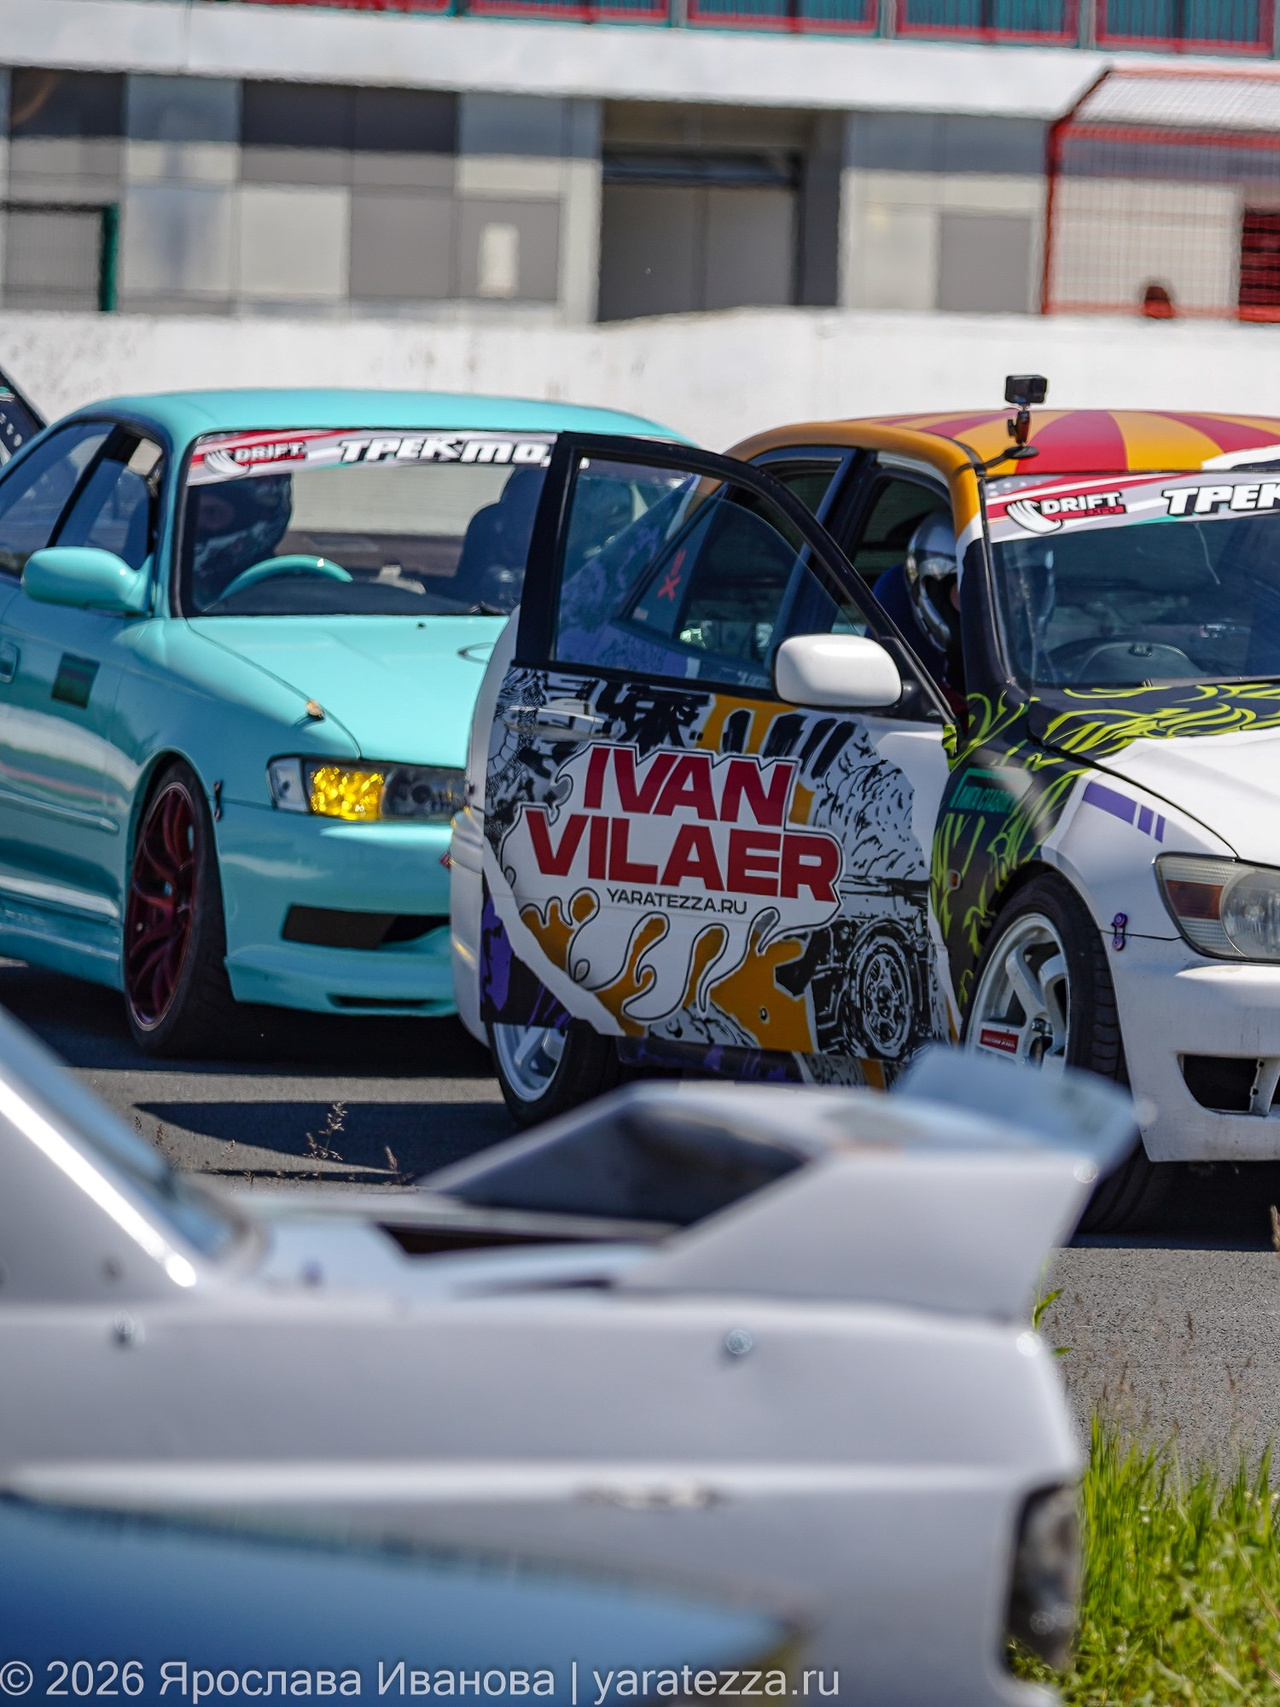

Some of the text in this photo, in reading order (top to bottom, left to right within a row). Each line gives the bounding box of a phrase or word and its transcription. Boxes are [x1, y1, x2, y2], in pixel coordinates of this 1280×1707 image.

[234, 442, 304, 462] DRIFT
[1041, 491, 1120, 515] DRIFT
[583, 746, 795, 827] IVAN
[525, 809, 841, 903] VILAER
[606, 887, 748, 915] YARATEZZA.RU
